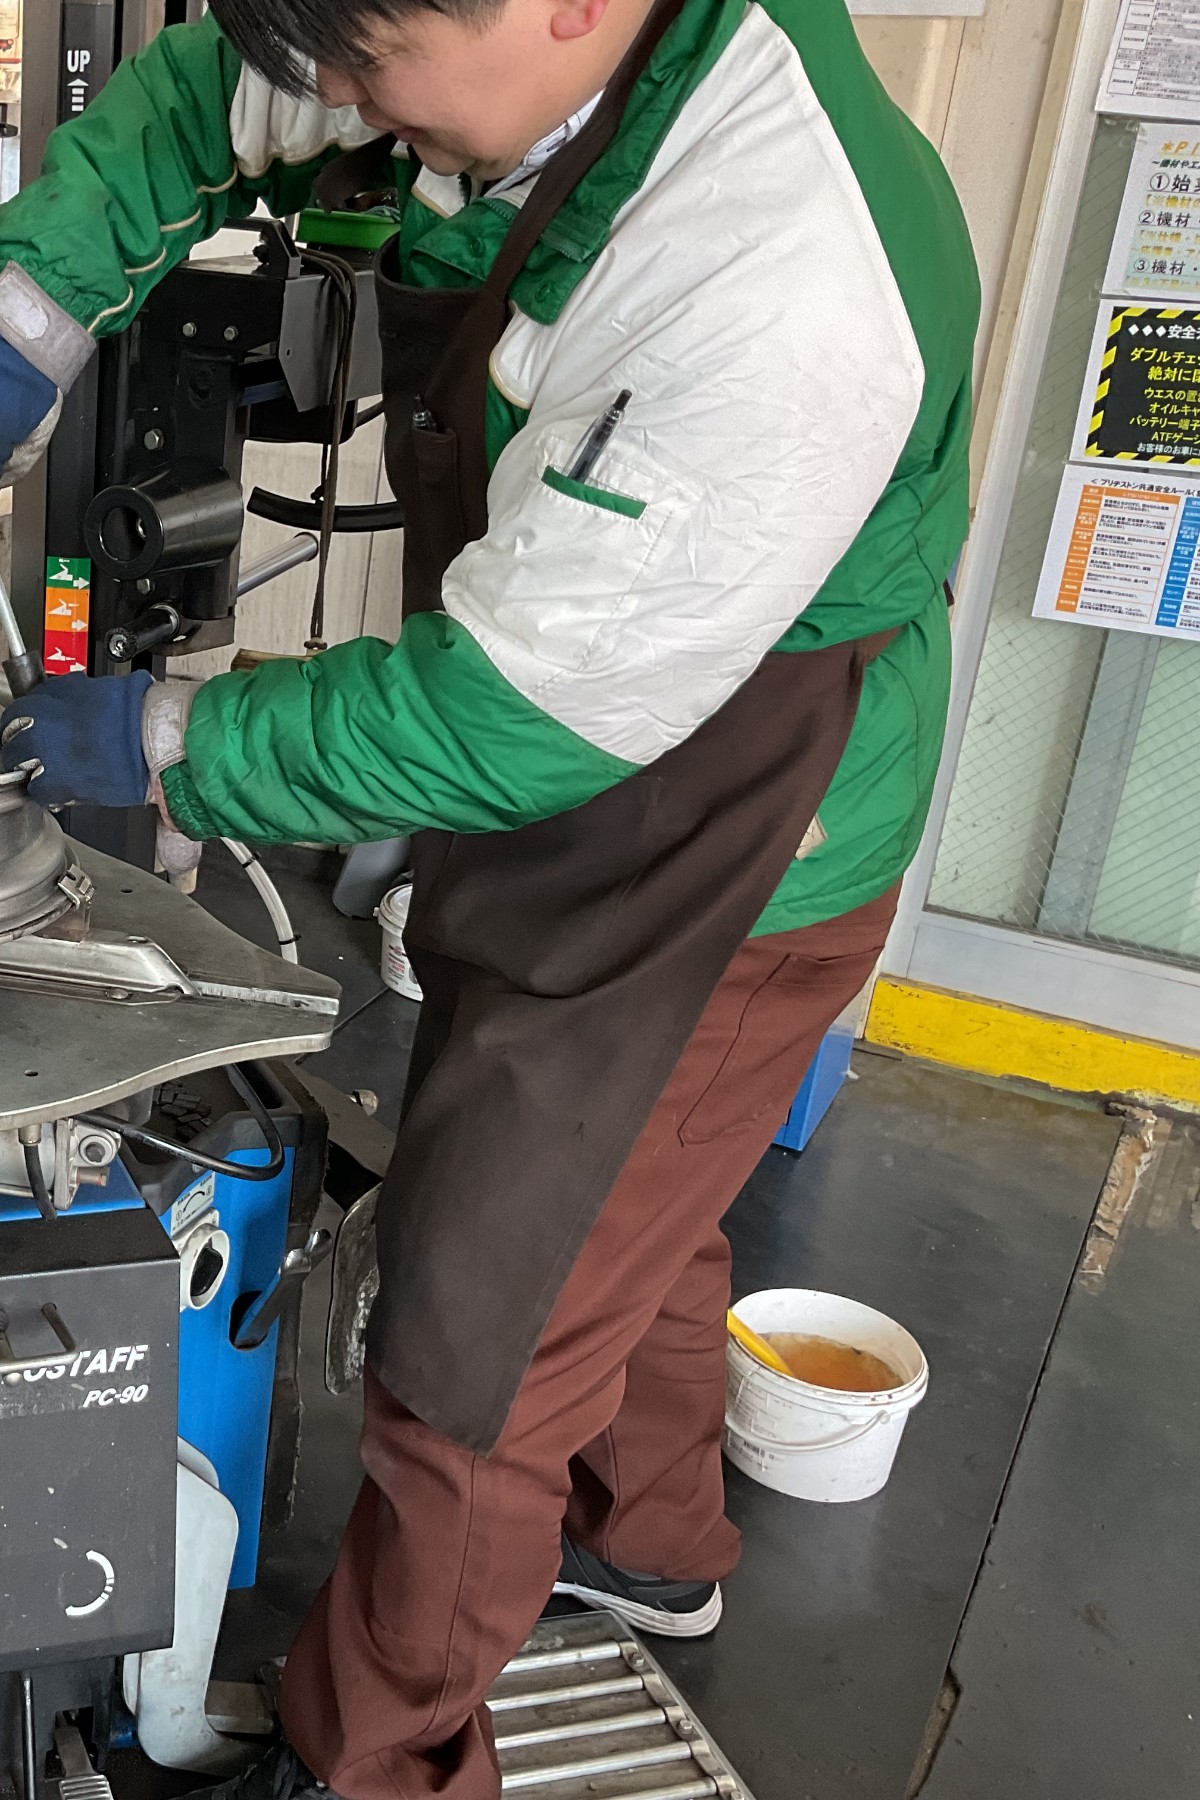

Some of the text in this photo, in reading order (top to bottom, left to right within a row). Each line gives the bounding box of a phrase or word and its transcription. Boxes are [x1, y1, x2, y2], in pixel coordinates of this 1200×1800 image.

[67, 50, 91, 73] UP
[1131, 347, 1200, 366] ダブルチェ
[1144, 387, 1200, 402] ウエスの置
[1137, 442, 1200, 457] お客様のお車に
[82, 1384, 149, 1408] PC-90
